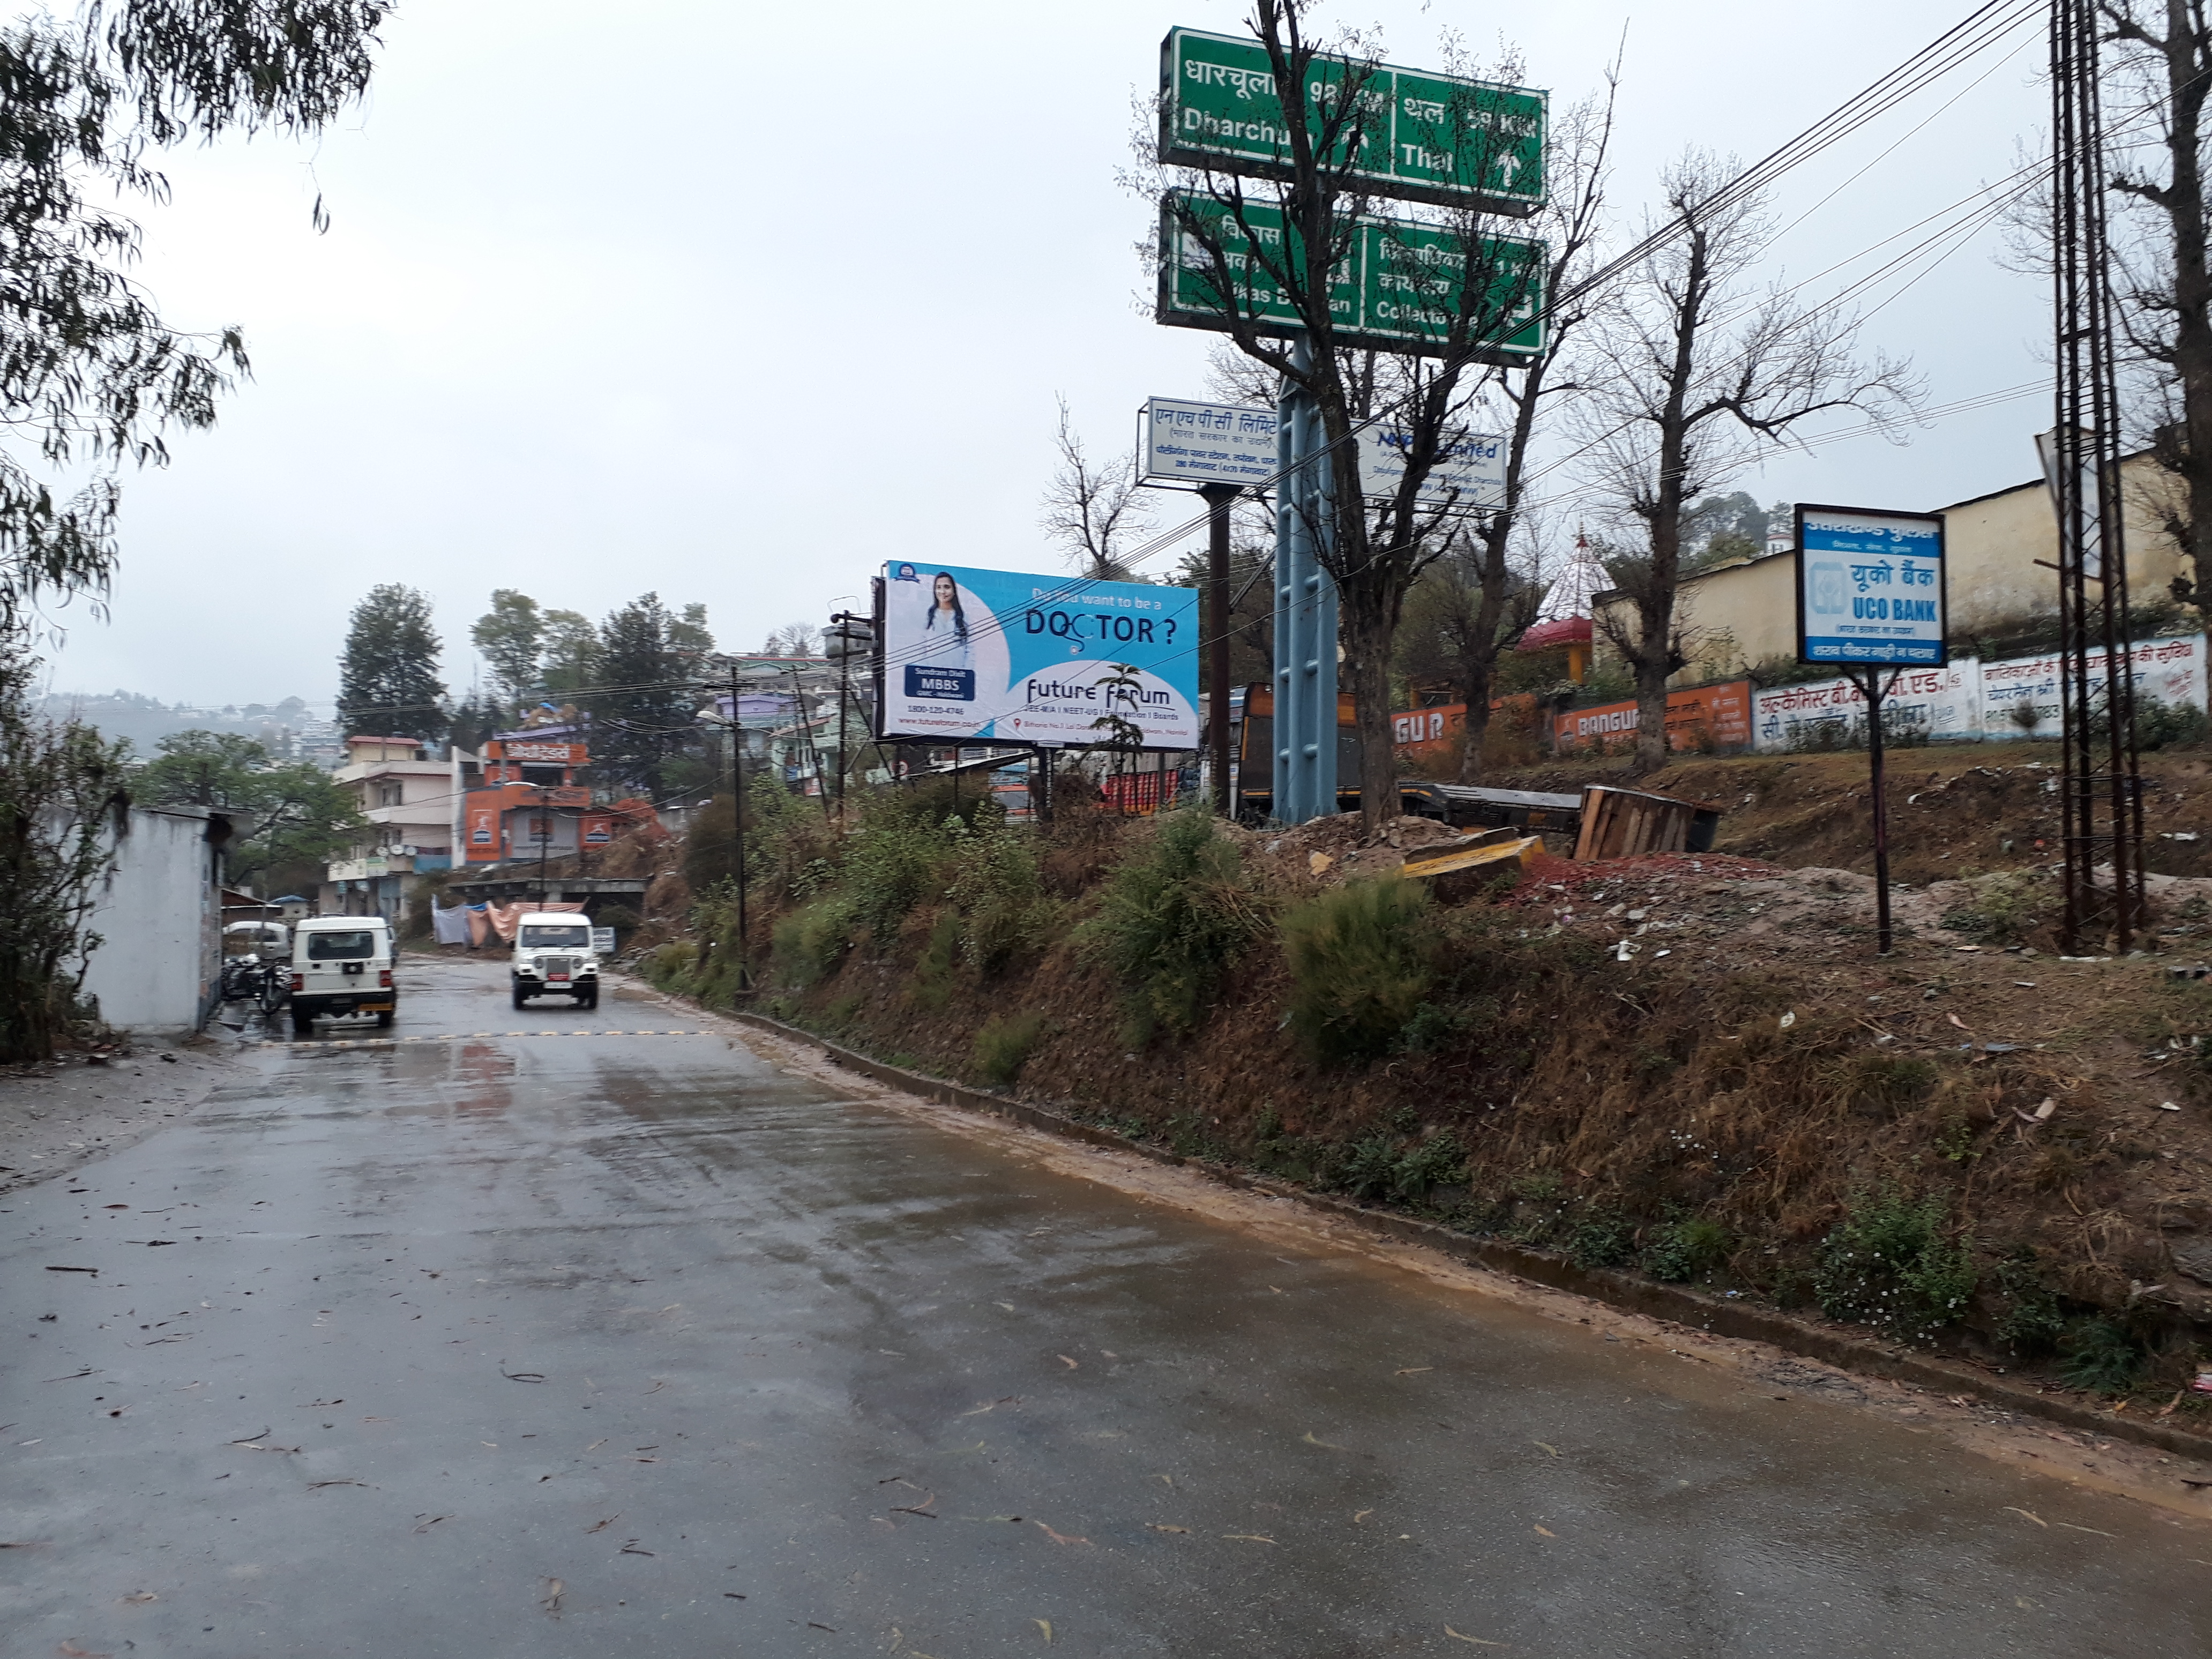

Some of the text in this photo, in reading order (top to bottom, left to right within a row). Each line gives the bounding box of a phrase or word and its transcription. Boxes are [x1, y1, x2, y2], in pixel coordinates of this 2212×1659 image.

[1183, 107, 1314, 151] Dharchu
[1400, 143, 1454, 173] Thal
[1238, 413, 1277, 435] लिमिटे
[1849, 559, 1895, 593] यूको
[1082, 594, 1115, 607] want
[1118, 596, 1132, 608] to
[1134, 597, 1151, 609] be
[1154, 601, 1162, 610] a
[1852, 596, 1938, 622] UCO BANK
[1026, 609, 1155, 644] DOCTOR
[921, 678, 960, 691] MBBS
[1027, 678, 1096, 703] future
[1394, 712, 1445, 744] GUR
